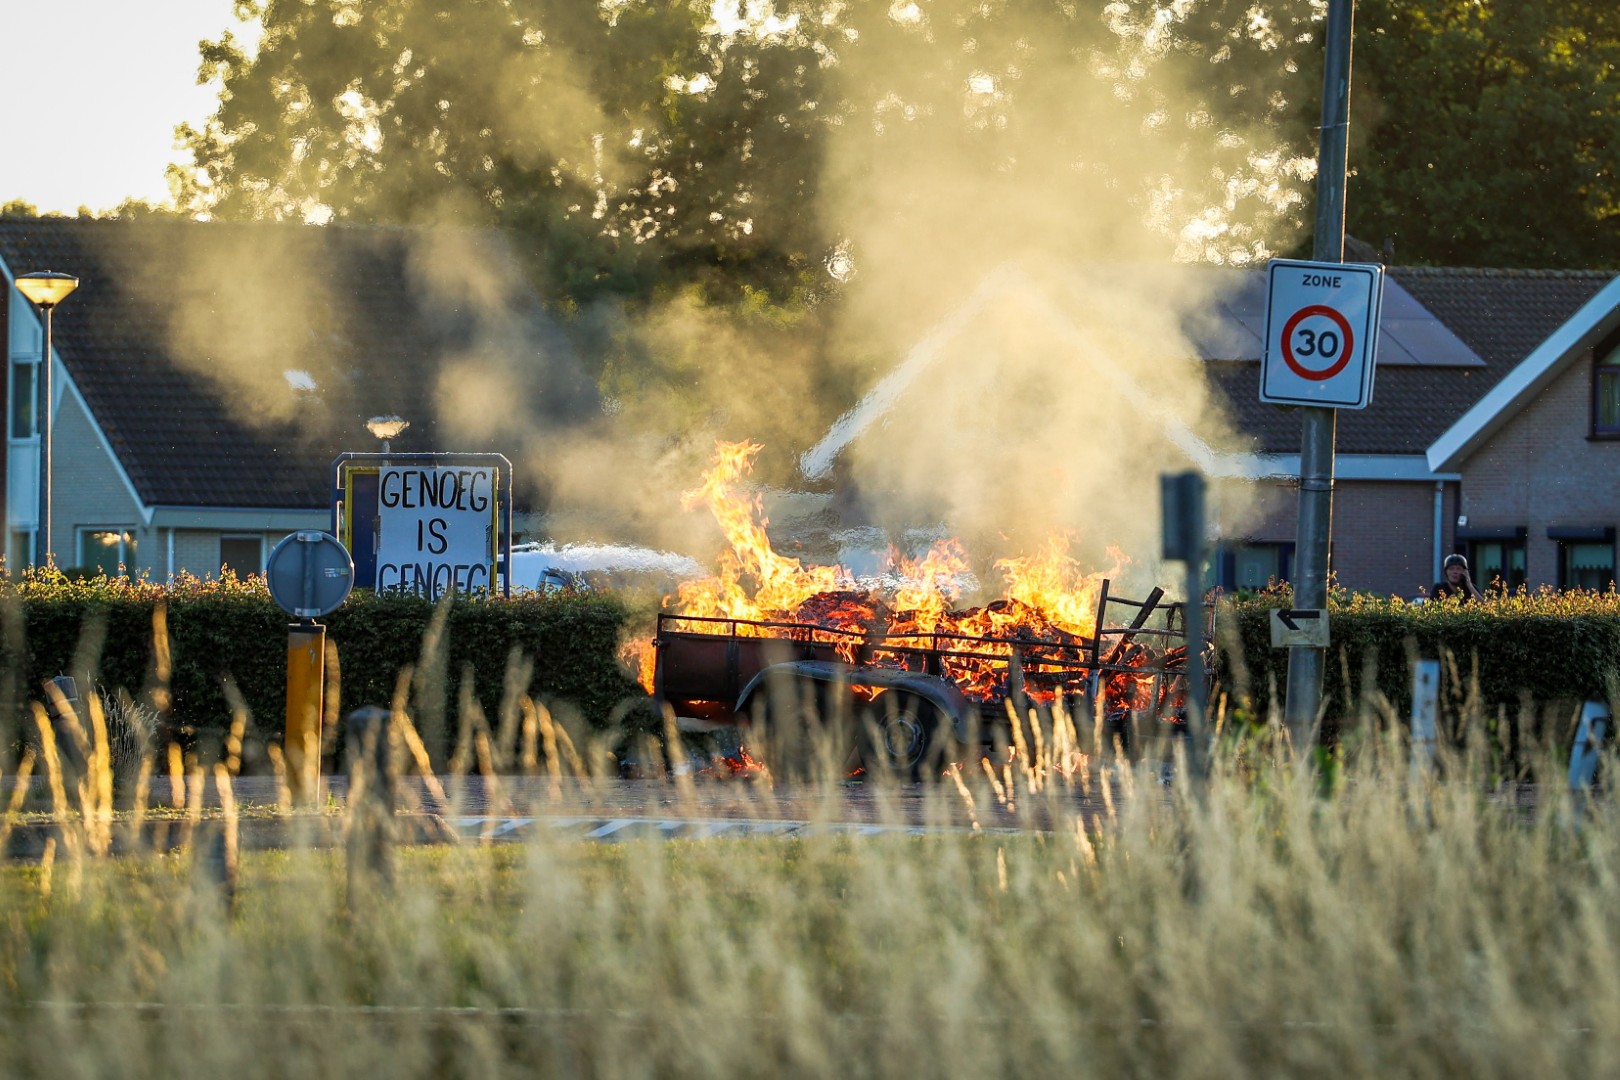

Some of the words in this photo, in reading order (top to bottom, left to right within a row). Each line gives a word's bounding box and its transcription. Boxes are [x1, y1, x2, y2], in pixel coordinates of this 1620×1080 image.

[1302, 274, 1342, 288] ZONE
[1296, 329, 1338, 358] 30
[381, 471, 488, 512] GENOEG
[417, 519, 448, 554] IS
